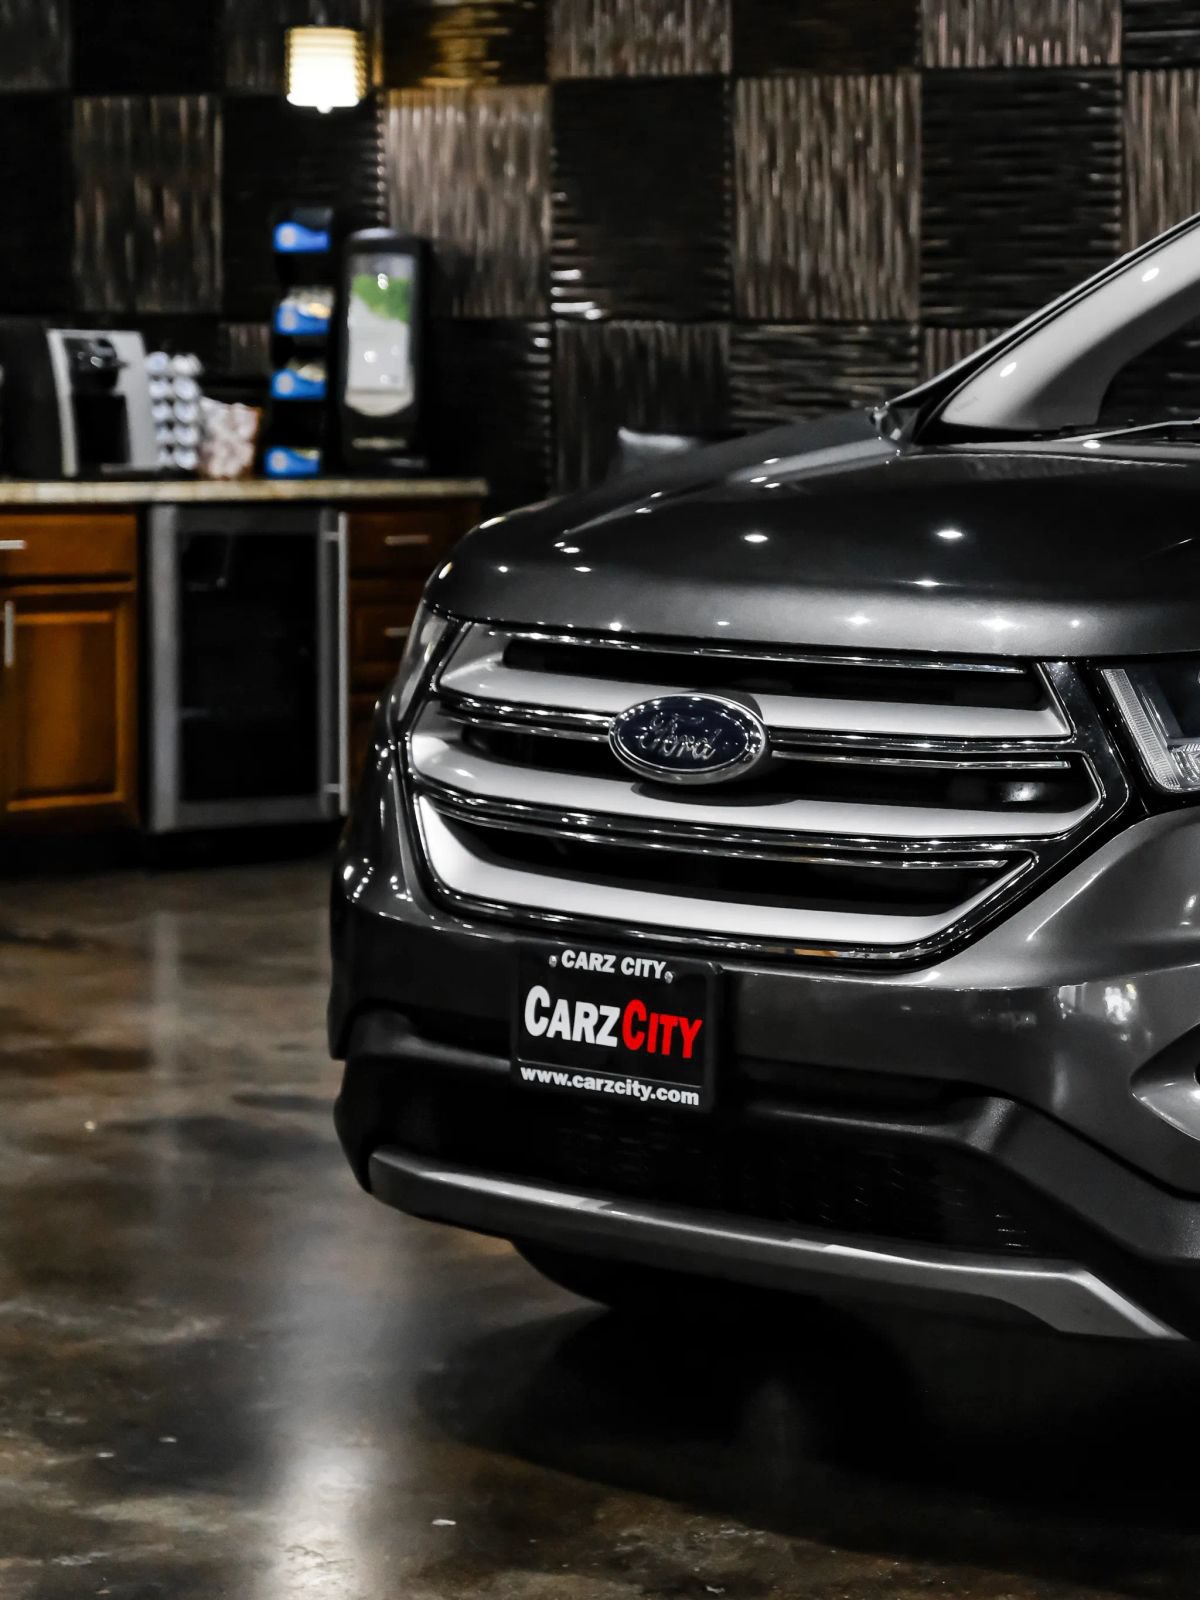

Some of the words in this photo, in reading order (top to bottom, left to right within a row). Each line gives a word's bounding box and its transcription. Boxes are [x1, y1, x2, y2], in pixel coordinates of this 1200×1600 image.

[635, 712, 722, 757] Ford
[561, 949, 616, 973] CARZ
[621, 957, 666, 979] CITY
[520, 1066, 699, 1106] www.carzcity.com
